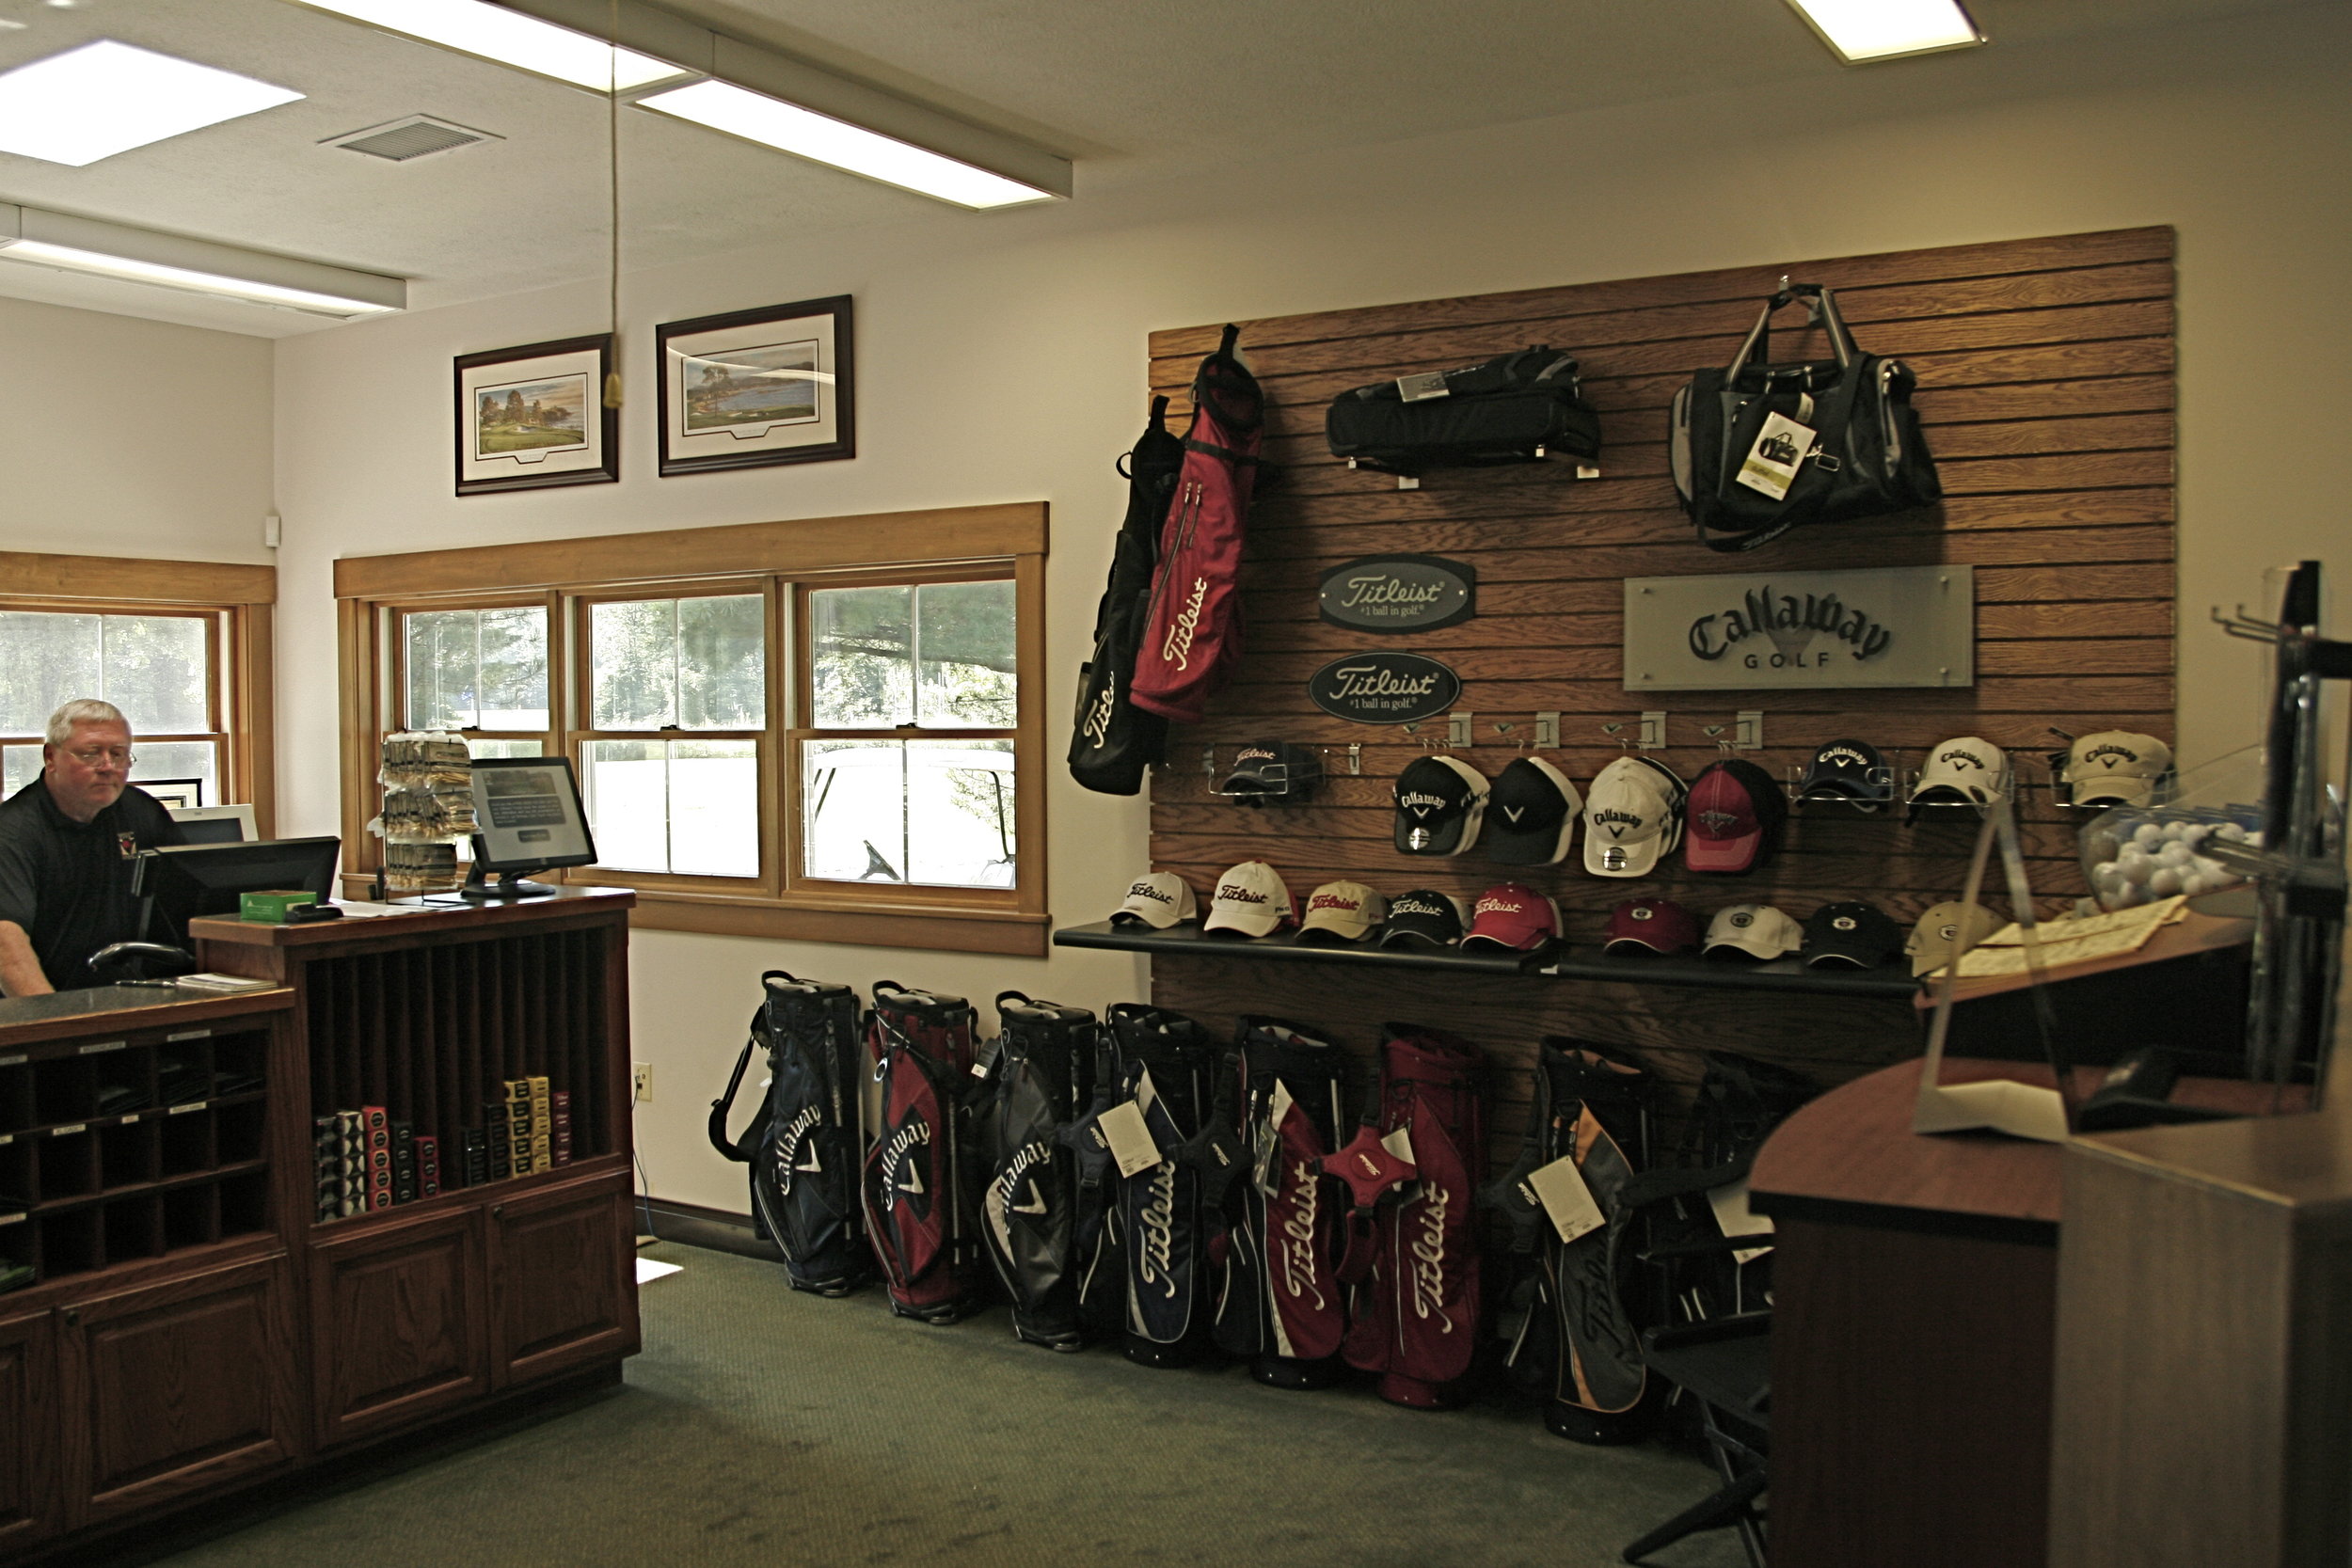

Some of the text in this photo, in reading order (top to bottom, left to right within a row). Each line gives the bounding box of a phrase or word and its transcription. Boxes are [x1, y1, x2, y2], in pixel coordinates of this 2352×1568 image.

[1342, 575, 1441, 608] Titleist
[1373, 606, 1390, 616] ball
[1391, 607, 1400, 616] in
[1690, 585, 1890, 660] Callaway
[1163, 577, 1207, 671] Titleist
[1745, 652, 1829, 669] GOLF
[1329, 665, 1436, 700] Titleist
[1362, 698, 1378, 709] ball
[1380, 698, 1391, 709] in
[1819, 747, 1868, 765] Callaway
[1401, 791, 1447, 810] Callaway
[1594, 809, 1643, 829] Callaway
[1127, 882, 1174, 905] Titleist
[1218, 884, 1268, 904] Titleist
[1309, 894, 1360, 911] Titleist
[1389, 900, 1443, 918] Titleist
[1473, 896, 1522, 919] Titleist
[772, 1103, 821, 1196] Callaway
[881, 1120, 930, 1212] Callaway
[1279, 1161, 1326, 1311] Titleist
[1409, 1181, 1453, 1334] Titleist
